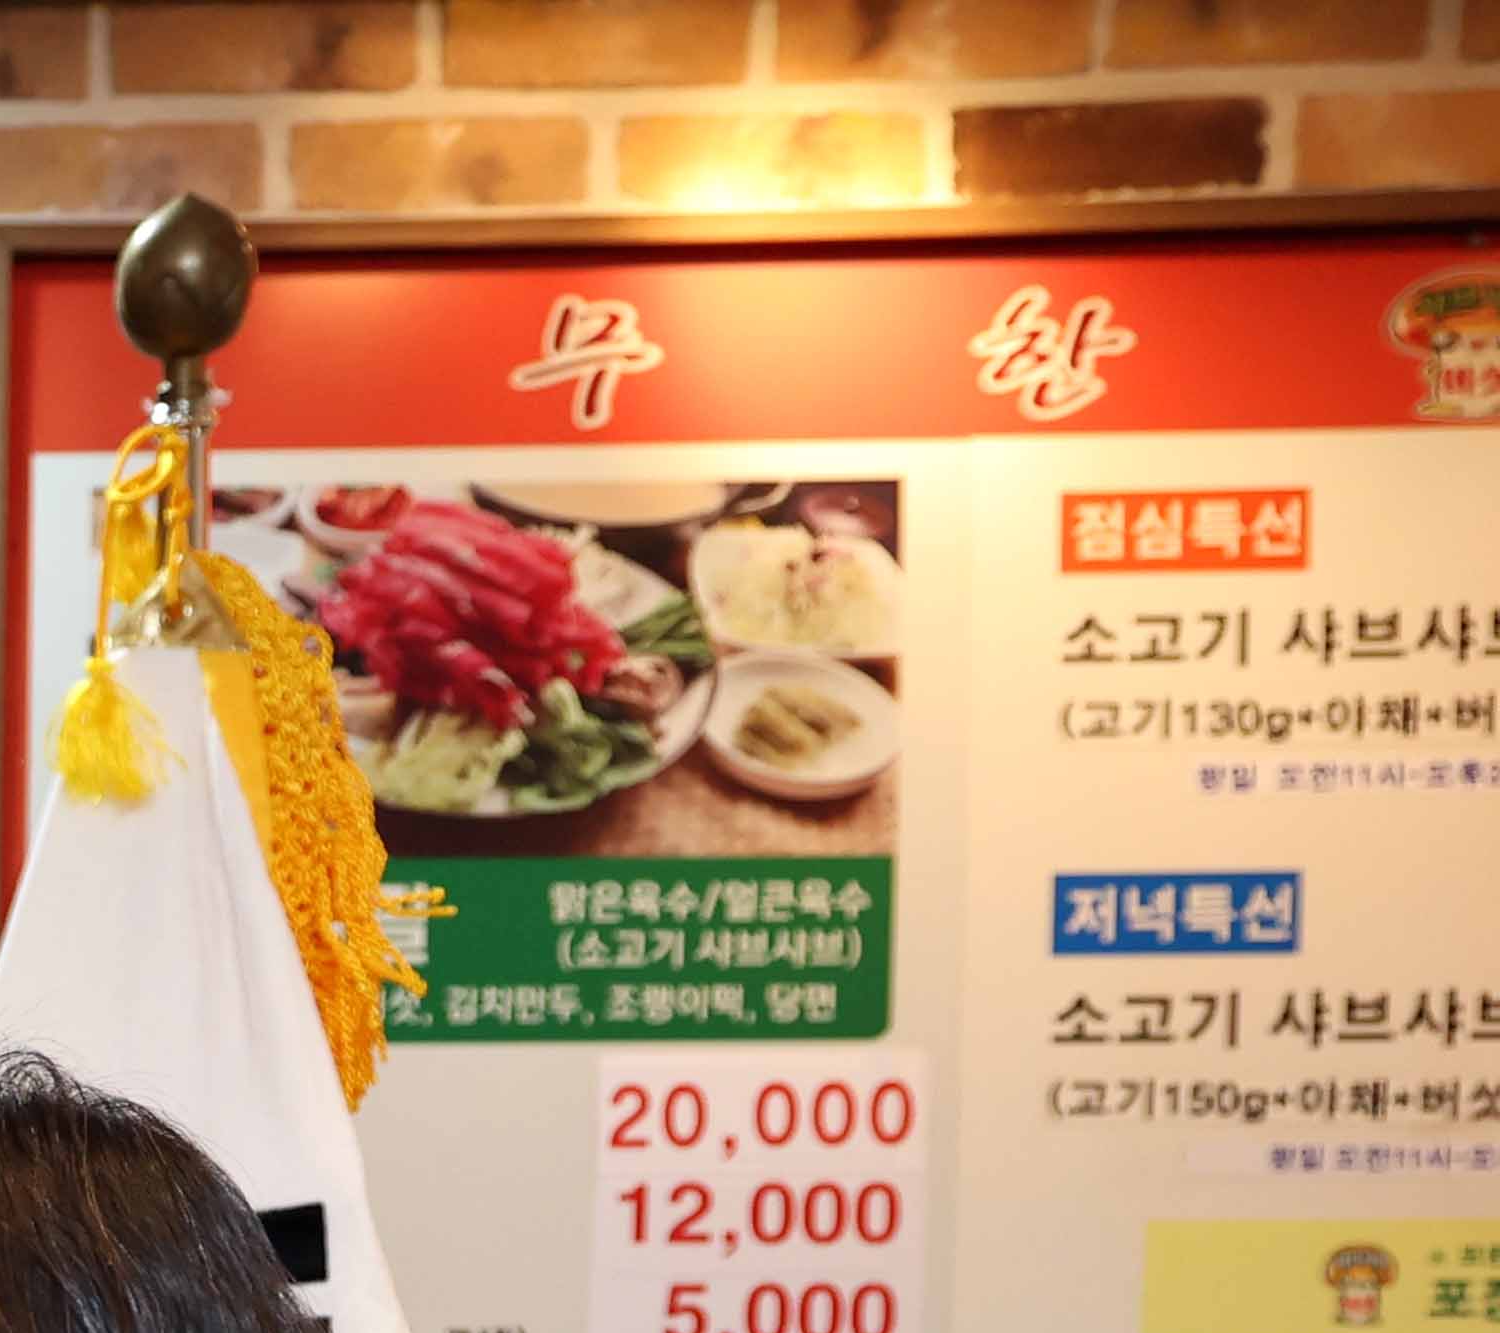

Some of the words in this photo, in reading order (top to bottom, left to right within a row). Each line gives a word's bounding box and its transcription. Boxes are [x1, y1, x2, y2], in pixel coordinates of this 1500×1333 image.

[508, 294, 665, 430] 무
[1070, 497, 1304, 562] 점심특선
[1061, 608, 1251, 666] 소고기
[1065, 882, 1295, 944] 저녁특선
[556, 928, 686, 971] (소고기
[1051, 990, 1240, 1048] 소고기
[609, 1081, 917, 1160] 20,000
[619, 1181, 902, 1257] 12,000
